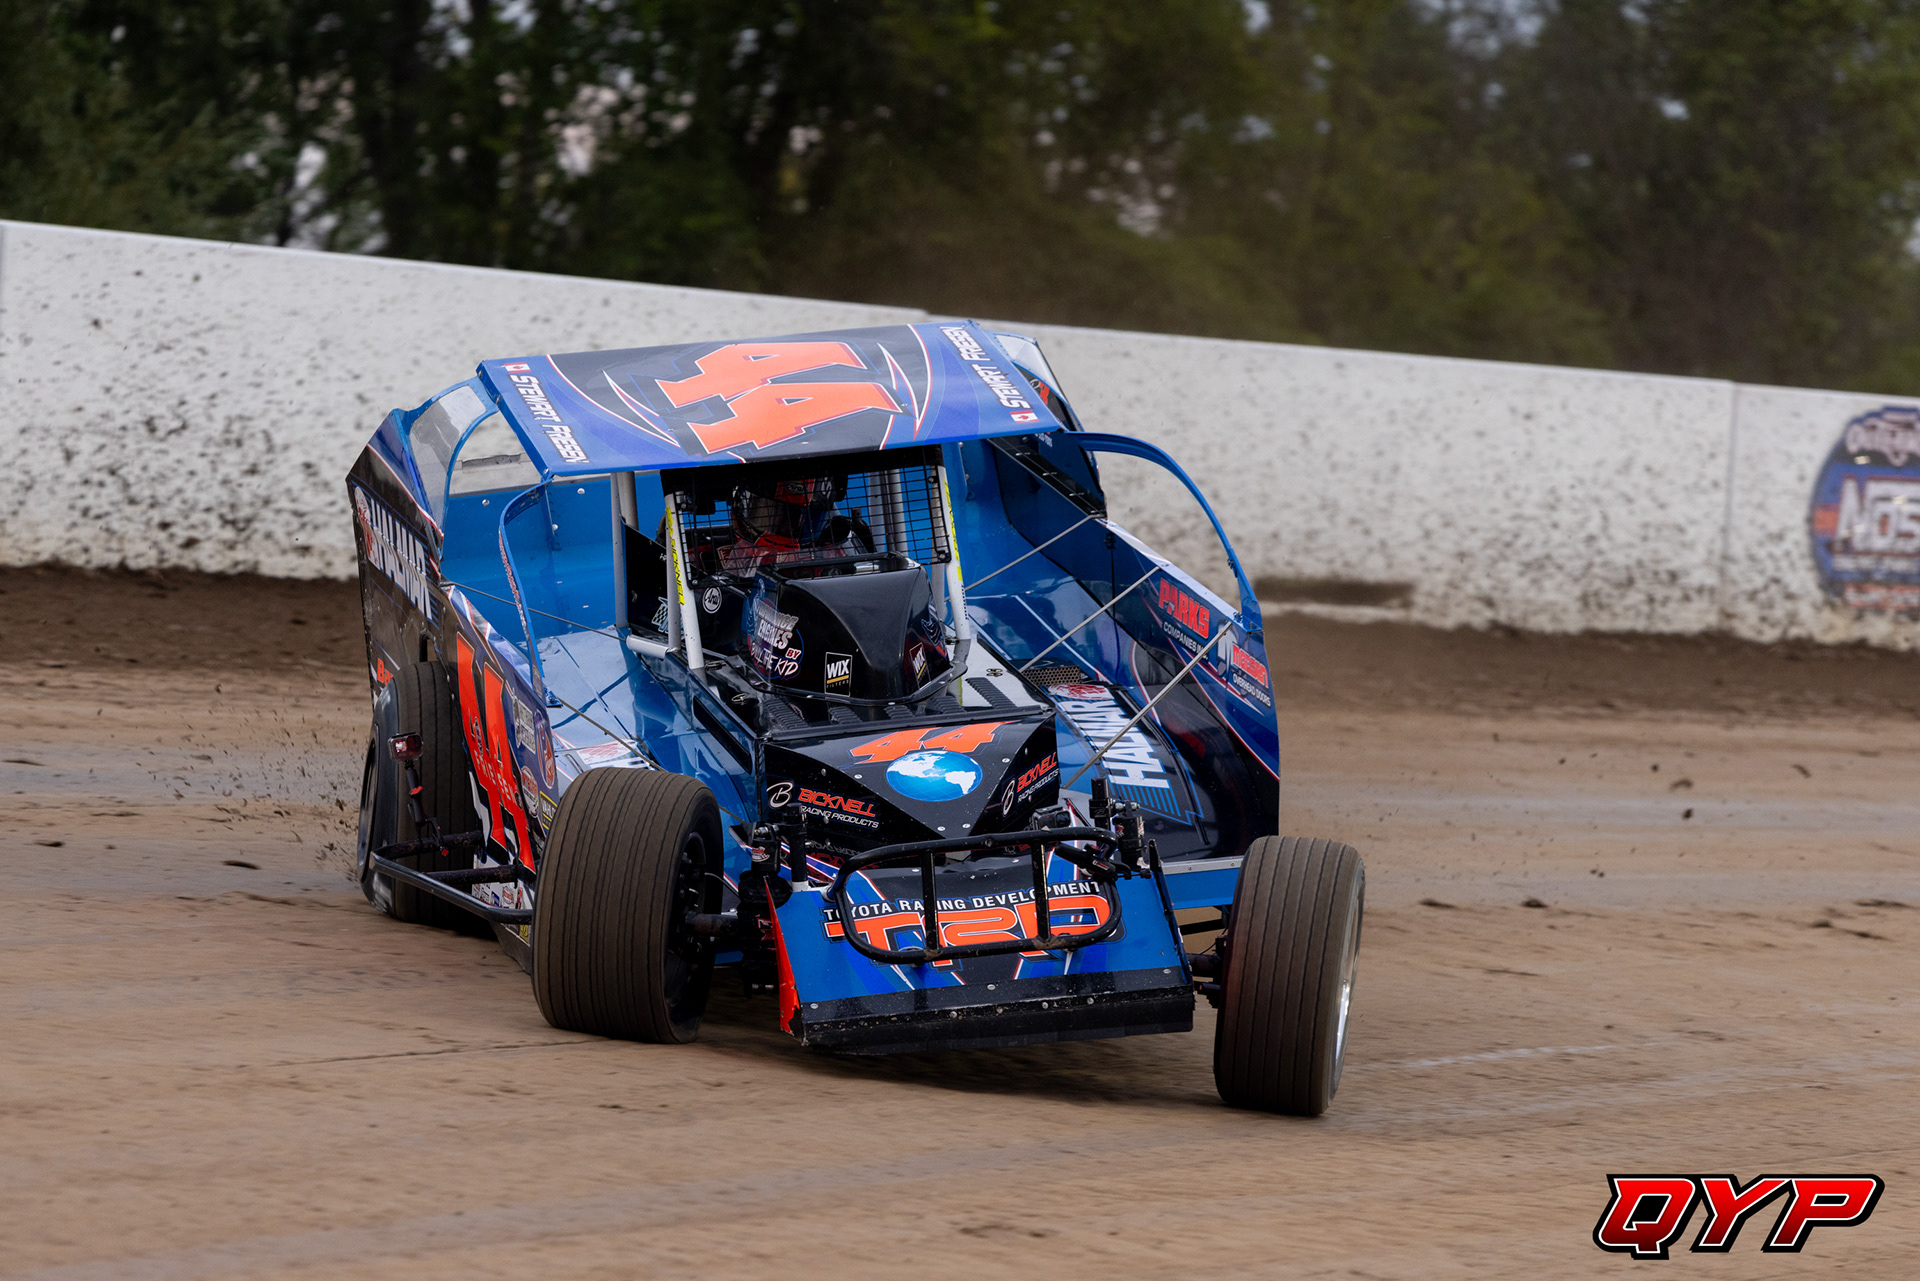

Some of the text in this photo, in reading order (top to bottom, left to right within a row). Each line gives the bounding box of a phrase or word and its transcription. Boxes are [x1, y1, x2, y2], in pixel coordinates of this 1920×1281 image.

[938, 325, 1032, 409] STEWART FRIESEN
[655, 342, 903, 455] 44
[508, 374, 593, 464] STEWART FRIESEN
[1158, 577, 1210, 639] PARKS
[1163, 621, 1197, 652] COMPANIES
[774, 658, 799, 676] KID
[785, 647, 802, 660] BY
[826, 658, 850, 679] WIX
[912, 646, 926, 674] WIX
[850, 719, 1020, 764] 44
[1058, 700, 1170, 788] HALMAR
[1017, 752, 1057, 793] BICKNELL
[798, 788, 876, 817] BICKNELL
[800, 805, 880, 829] RACING PRODUCTS
[823, 902, 892, 920] TYOTA
[899, 899, 966, 911] RAING
